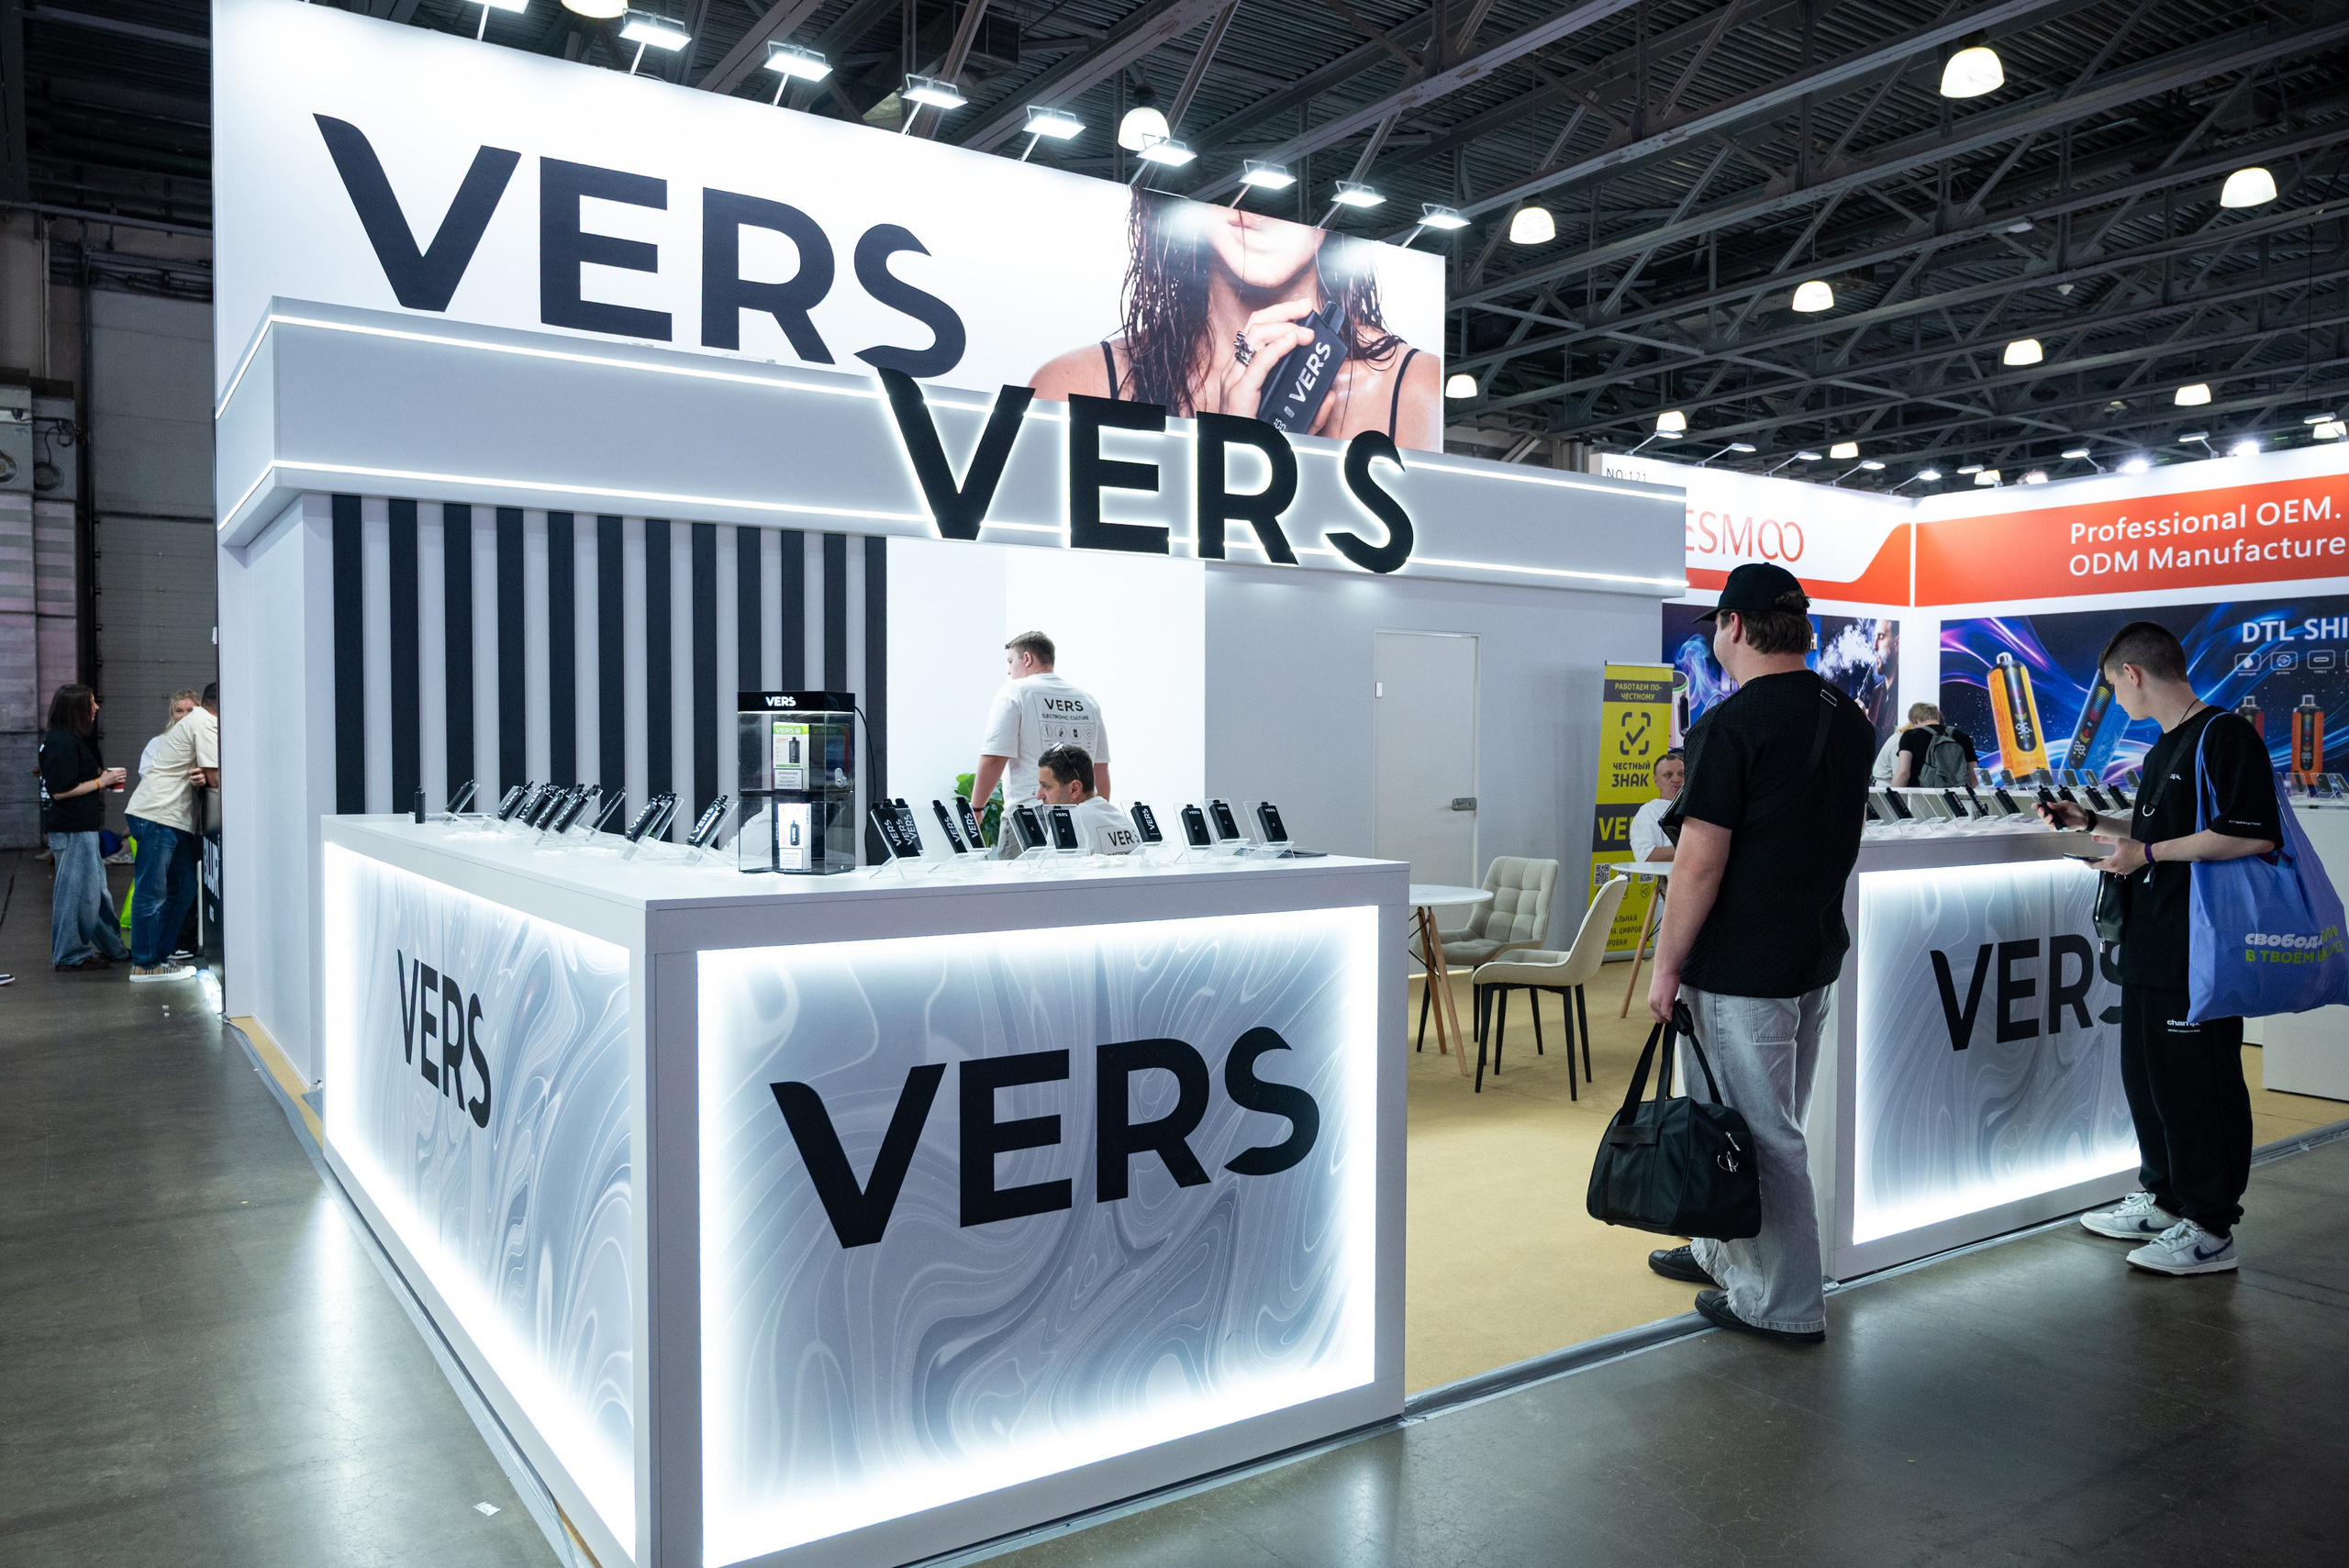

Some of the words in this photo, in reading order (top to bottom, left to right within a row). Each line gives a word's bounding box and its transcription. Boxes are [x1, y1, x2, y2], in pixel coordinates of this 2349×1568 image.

[313, 113, 966, 378] VERS
[1288, 341, 1330, 402] VERS
[877, 367, 1414, 573] VERS
[2070, 504, 2246, 544] Professional
[2255, 495, 2342, 526] OEM.
[2069, 549, 2138, 576] ODM
[2148, 536, 2347, 570] Manufacture
[2242, 620, 2295, 643] DTL
[2304, 617, 2349, 640] SHI
[1614, 683, 1649, 691] РАБОТАЕМ
[1620, 693, 1655, 701] ЧЕСТНОМУ
[764, 695, 796, 707] VERS
[1044, 697, 1085, 712] VERS
[774, 727, 796, 735] VERS
[1612, 761, 1651, 771] ЧЕСТНЫЙ
[1611, 773, 1650, 788] ЗНАК
[692, 807, 715, 834] VERS
[904, 814, 918, 840] VERS
[944, 816, 961, 843] VERS
[963, 813, 979, 839] VERS
[1141, 807, 1155, 830] VERS
[1598, 817, 1631, 841] VE
[884, 819, 903, 846] VERS
[896, 819, 913, 846] VERS
[2245, 949, 2256, 962] В
[2259, 948, 2315, 964] ТВОЁМ
[397, 948, 492, 1129] VERS
[769, 1026, 1320, 1250] VERS
